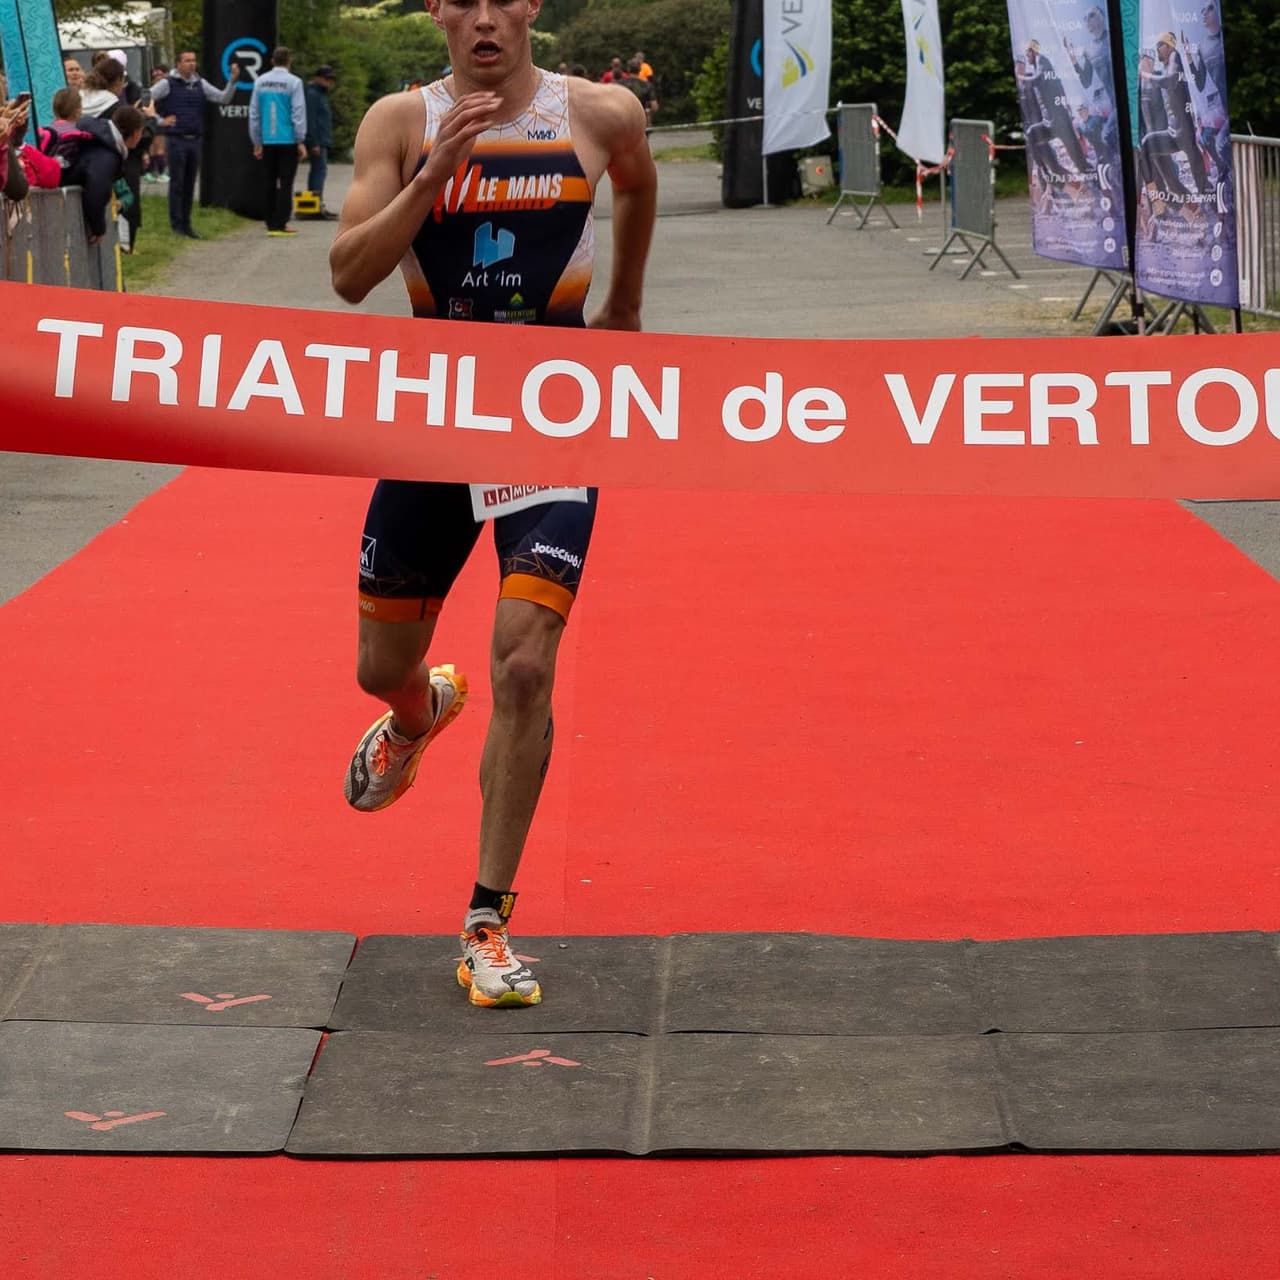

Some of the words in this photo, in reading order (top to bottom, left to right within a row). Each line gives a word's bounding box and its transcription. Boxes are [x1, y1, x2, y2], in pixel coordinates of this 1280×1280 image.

[477, 176, 499, 201] LE
[506, 173, 563, 200] MANS
[37, 318, 680, 440] TRIATHLON
[721, 371, 846, 443] de
